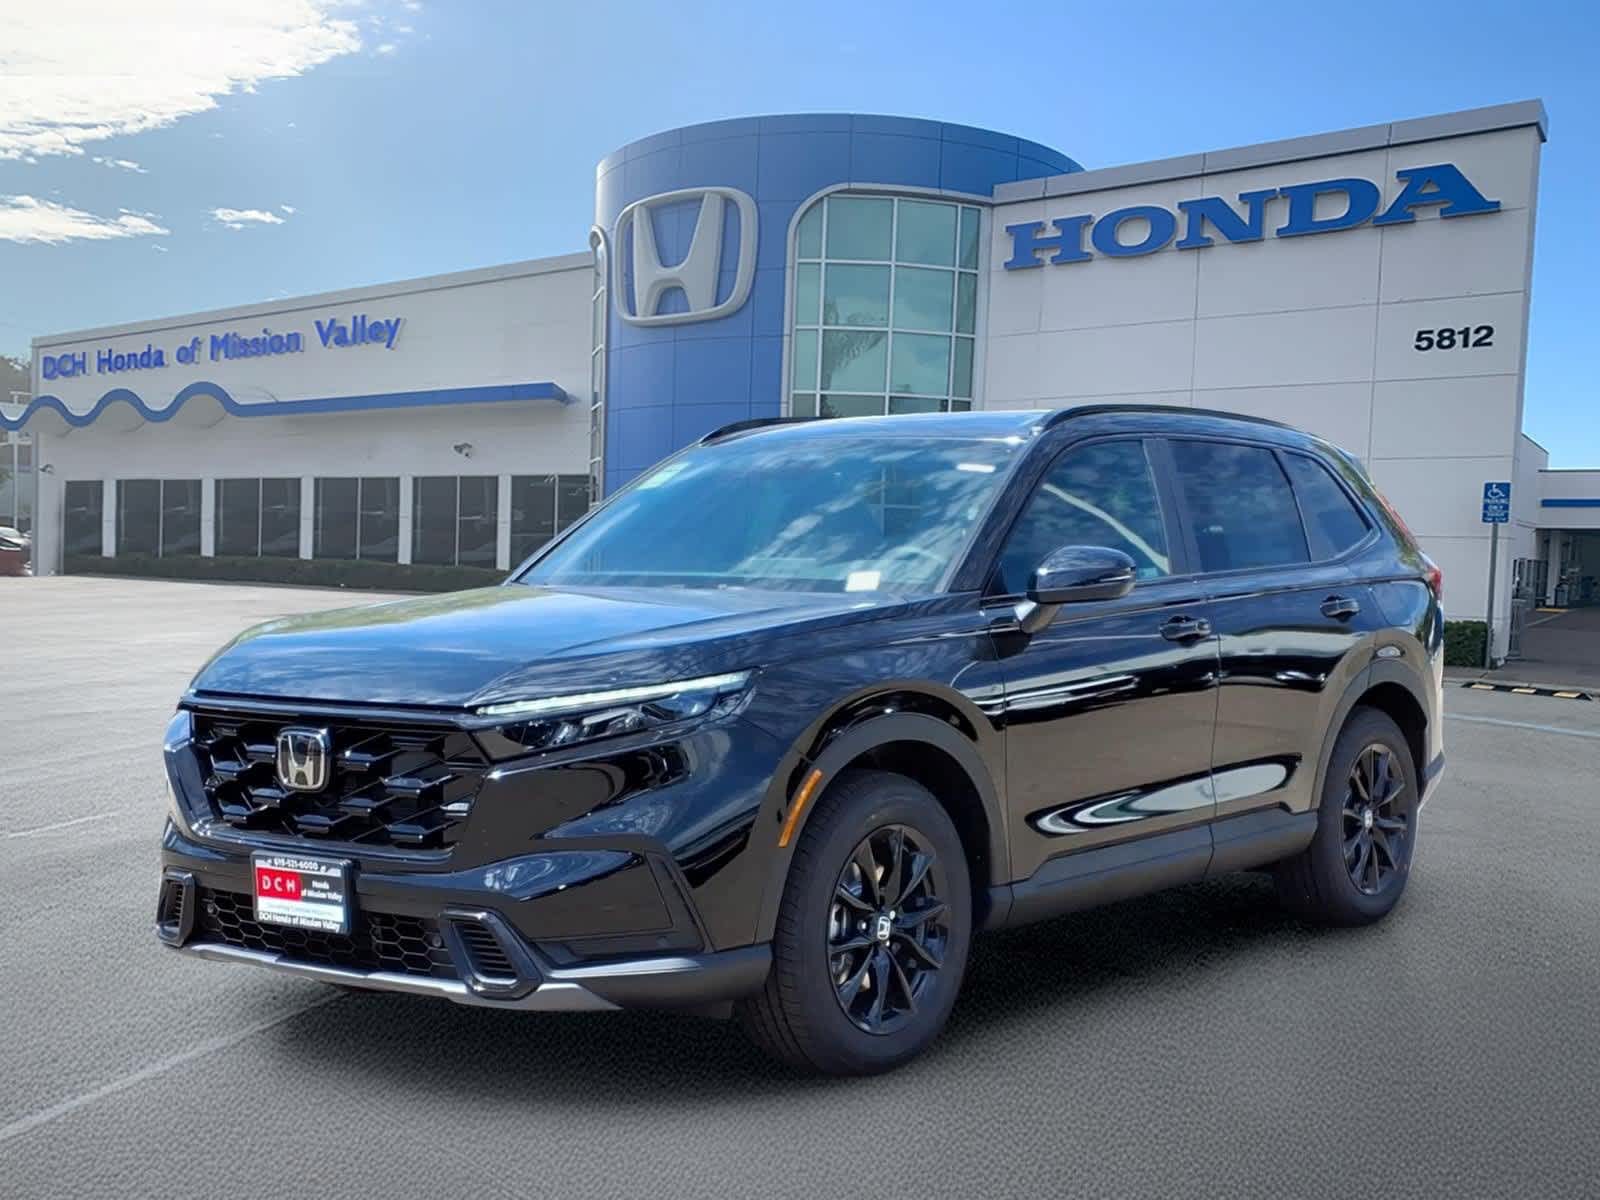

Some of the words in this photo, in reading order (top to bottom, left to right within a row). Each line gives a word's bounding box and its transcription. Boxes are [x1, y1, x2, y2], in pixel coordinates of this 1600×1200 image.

[1004, 163, 1502, 271] HONDA
[42, 351, 86, 380] DCH
[97, 344, 165, 375] Honda
[176, 337, 203, 365] of
[210, 329, 302, 362] Mission
[315, 314, 402, 350] Valley
[1414, 324, 1495, 353] 5812
